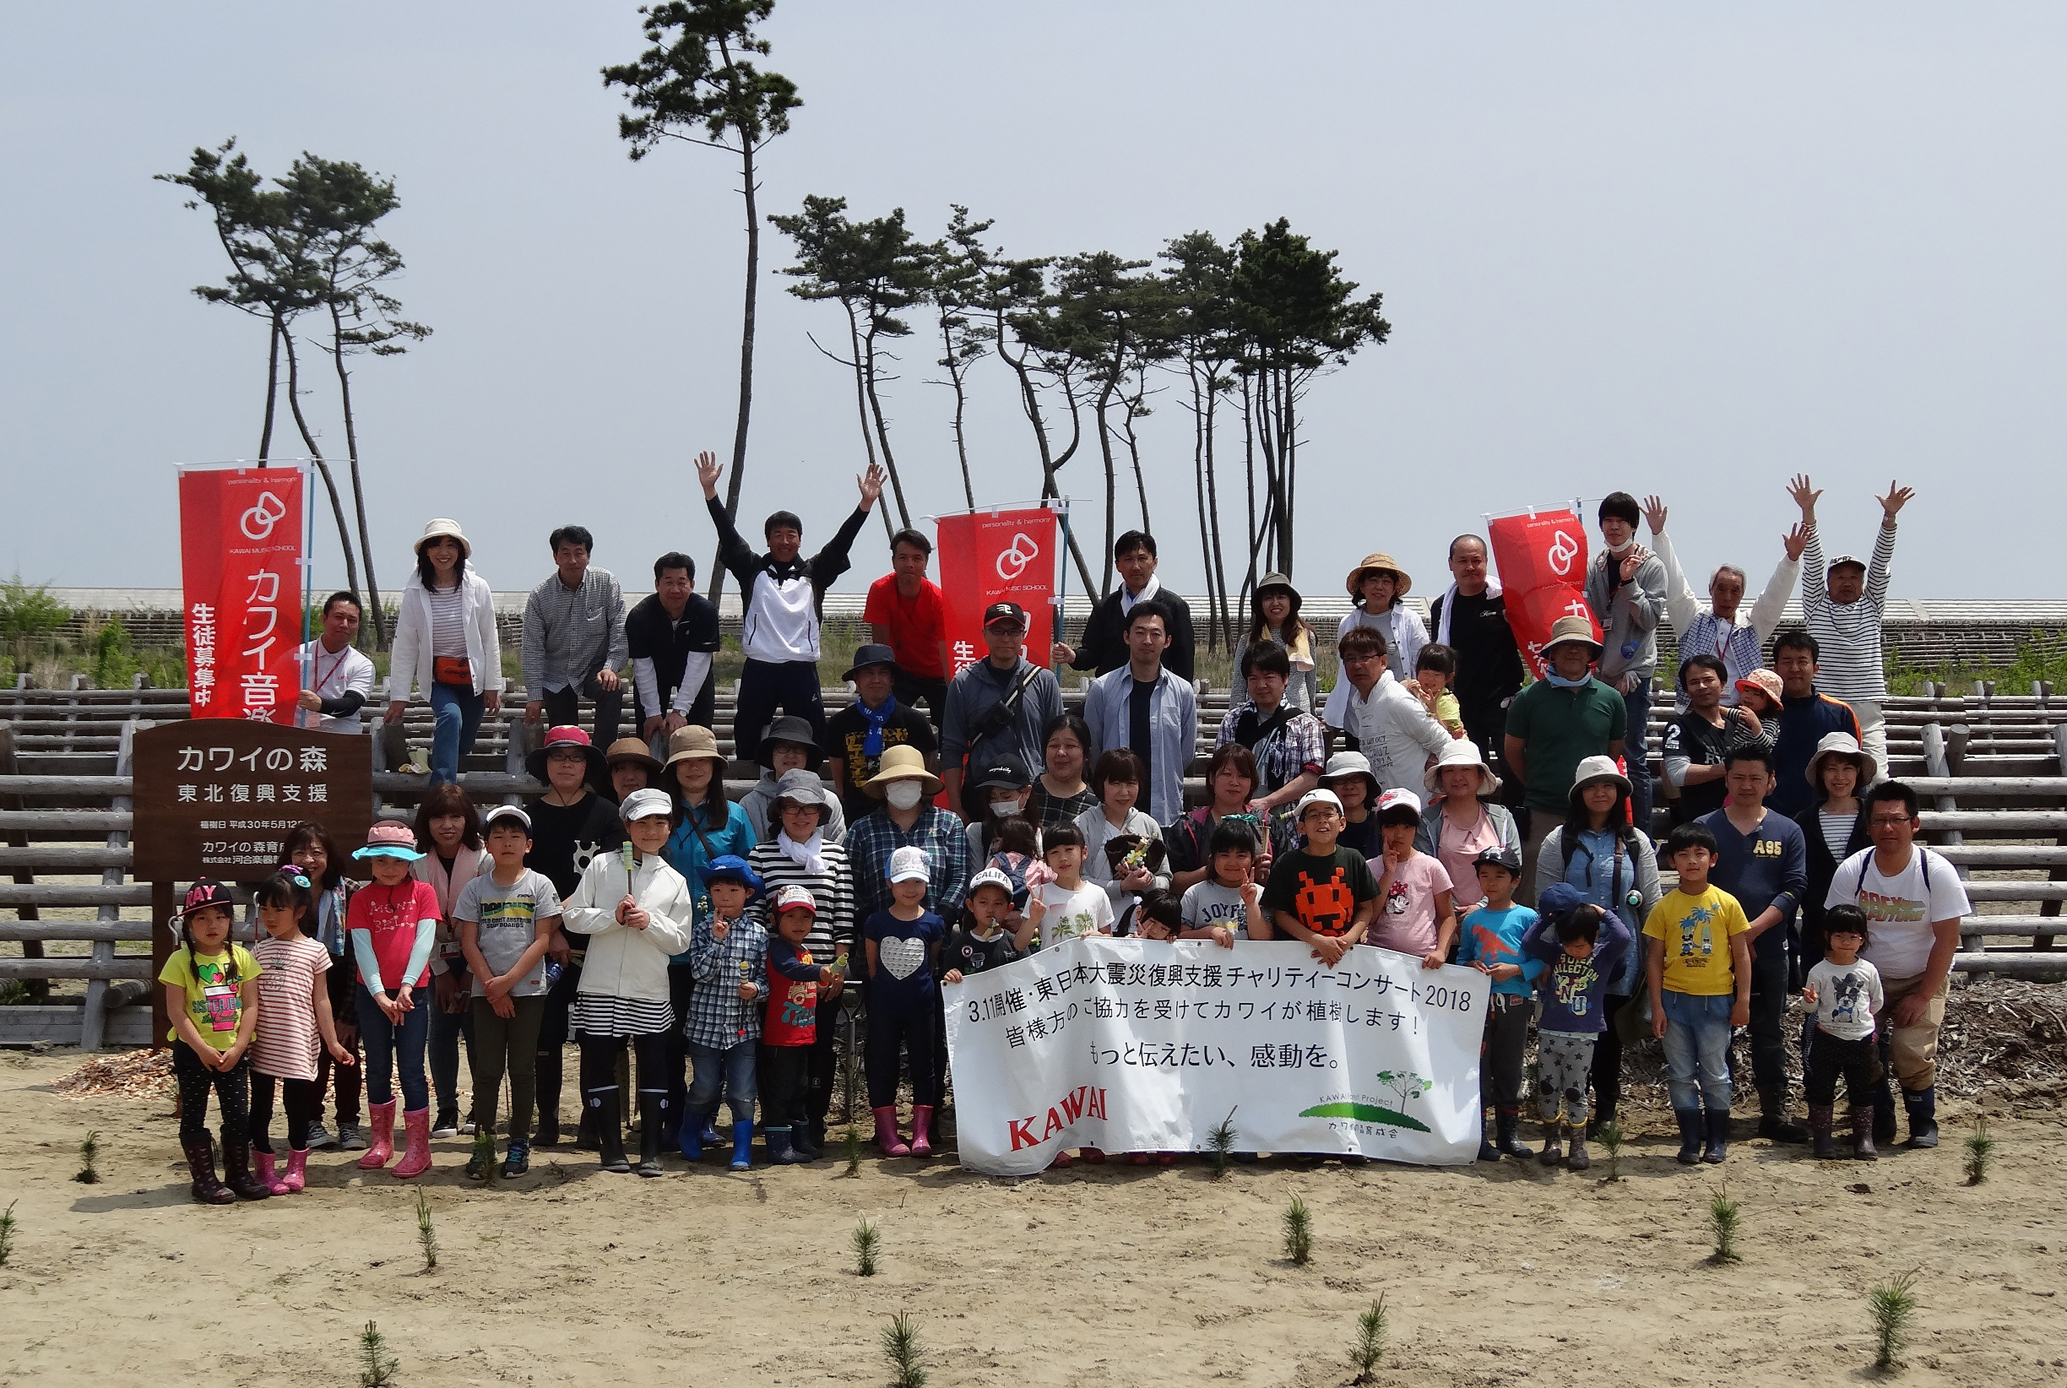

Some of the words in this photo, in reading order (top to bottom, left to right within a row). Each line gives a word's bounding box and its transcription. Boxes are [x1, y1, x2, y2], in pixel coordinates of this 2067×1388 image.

[192, 602, 217, 708] 生徒募集中
[1665, 723, 1681, 746] 2
[177, 745, 328, 773] カワイの森
[177, 783, 328, 803] 東北復興支援
[1752, 839, 1782, 856] A95
[1361, 1094, 1394, 1107] Project
[1007, 1085, 1108, 1152] KAWAI
